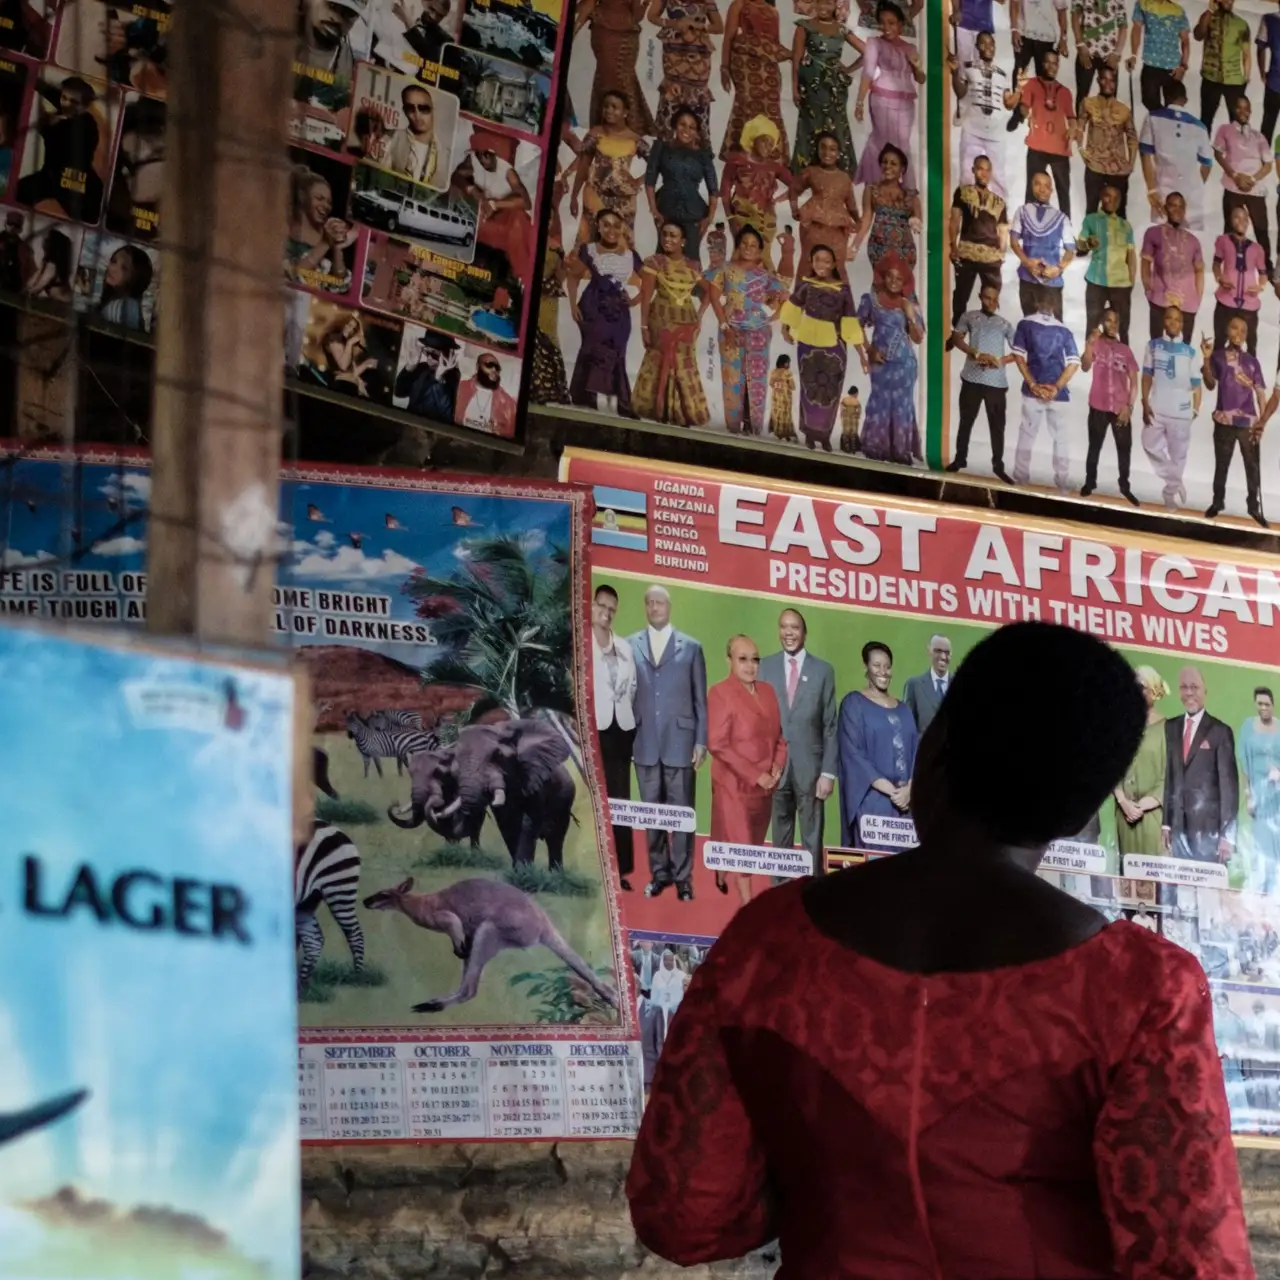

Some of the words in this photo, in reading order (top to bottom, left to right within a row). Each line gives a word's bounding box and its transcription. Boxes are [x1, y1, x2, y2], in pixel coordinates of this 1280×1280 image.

[654, 479, 705, 498] UGANDA
[653, 496, 715, 515] TANZANIA
[653, 510, 694, 526] KENYA
[654, 524, 698, 541] CONGO
[718, 483, 937, 572] EAST
[655, 538, 707, 557] RWANDA
[654, 554, 709, 573] BURUNDI
[32, 573, 54, 591] IS
[63, 573, 115, 592] FULL
[123, 574, 147, 592] OF
[47, 599, 117, 618] TOUGH
[272, 589, 310, 609] OME
[319, 592, 389, 615] BRIGHT
[769, 559, 958, 612] PRESIDENTS
[966, 586, 1040, 622] WITH
[1049, 600, 1134, 640] THEIR
[1141, 614, 1228, 653] WIVES
[294, 613, 316, 633] OF
[325, 618, 435, 643] DARKNESS.
[617, 815, 636, 824] FIRST
[638, 816, 656, 827] LADY
[882, 820, 914, 831] PRESIDEN
[863, 830, 876, 840] AND
[878, 832, 890, 841] THE
[892, 833, 910, 843] FIRST
[729, 847, 766, 859] PRESIDENT
[768, 851, 803, 862] KENYATTA
[1053, 857, 1069, 867] FIRST
[1071, 859, 1087, 868] LADY
[706, 856, 720, 865] AND
[722, 858, 735, 867] THE
[737, 860, 756, 869] FIRST
[758, 861, 776, 872] LADY
[777, 863, 810, 874] MARGRET
[23, 862, 252, 945] LAGER
[325, 1046, 396, 1059] SEPTEMBER
[414, 1045, 471, 1058] OCTOBER
[490, 1045, 553, 1056] NOVEMBER
[570, 1045, 630, 1056] DECEMBER
